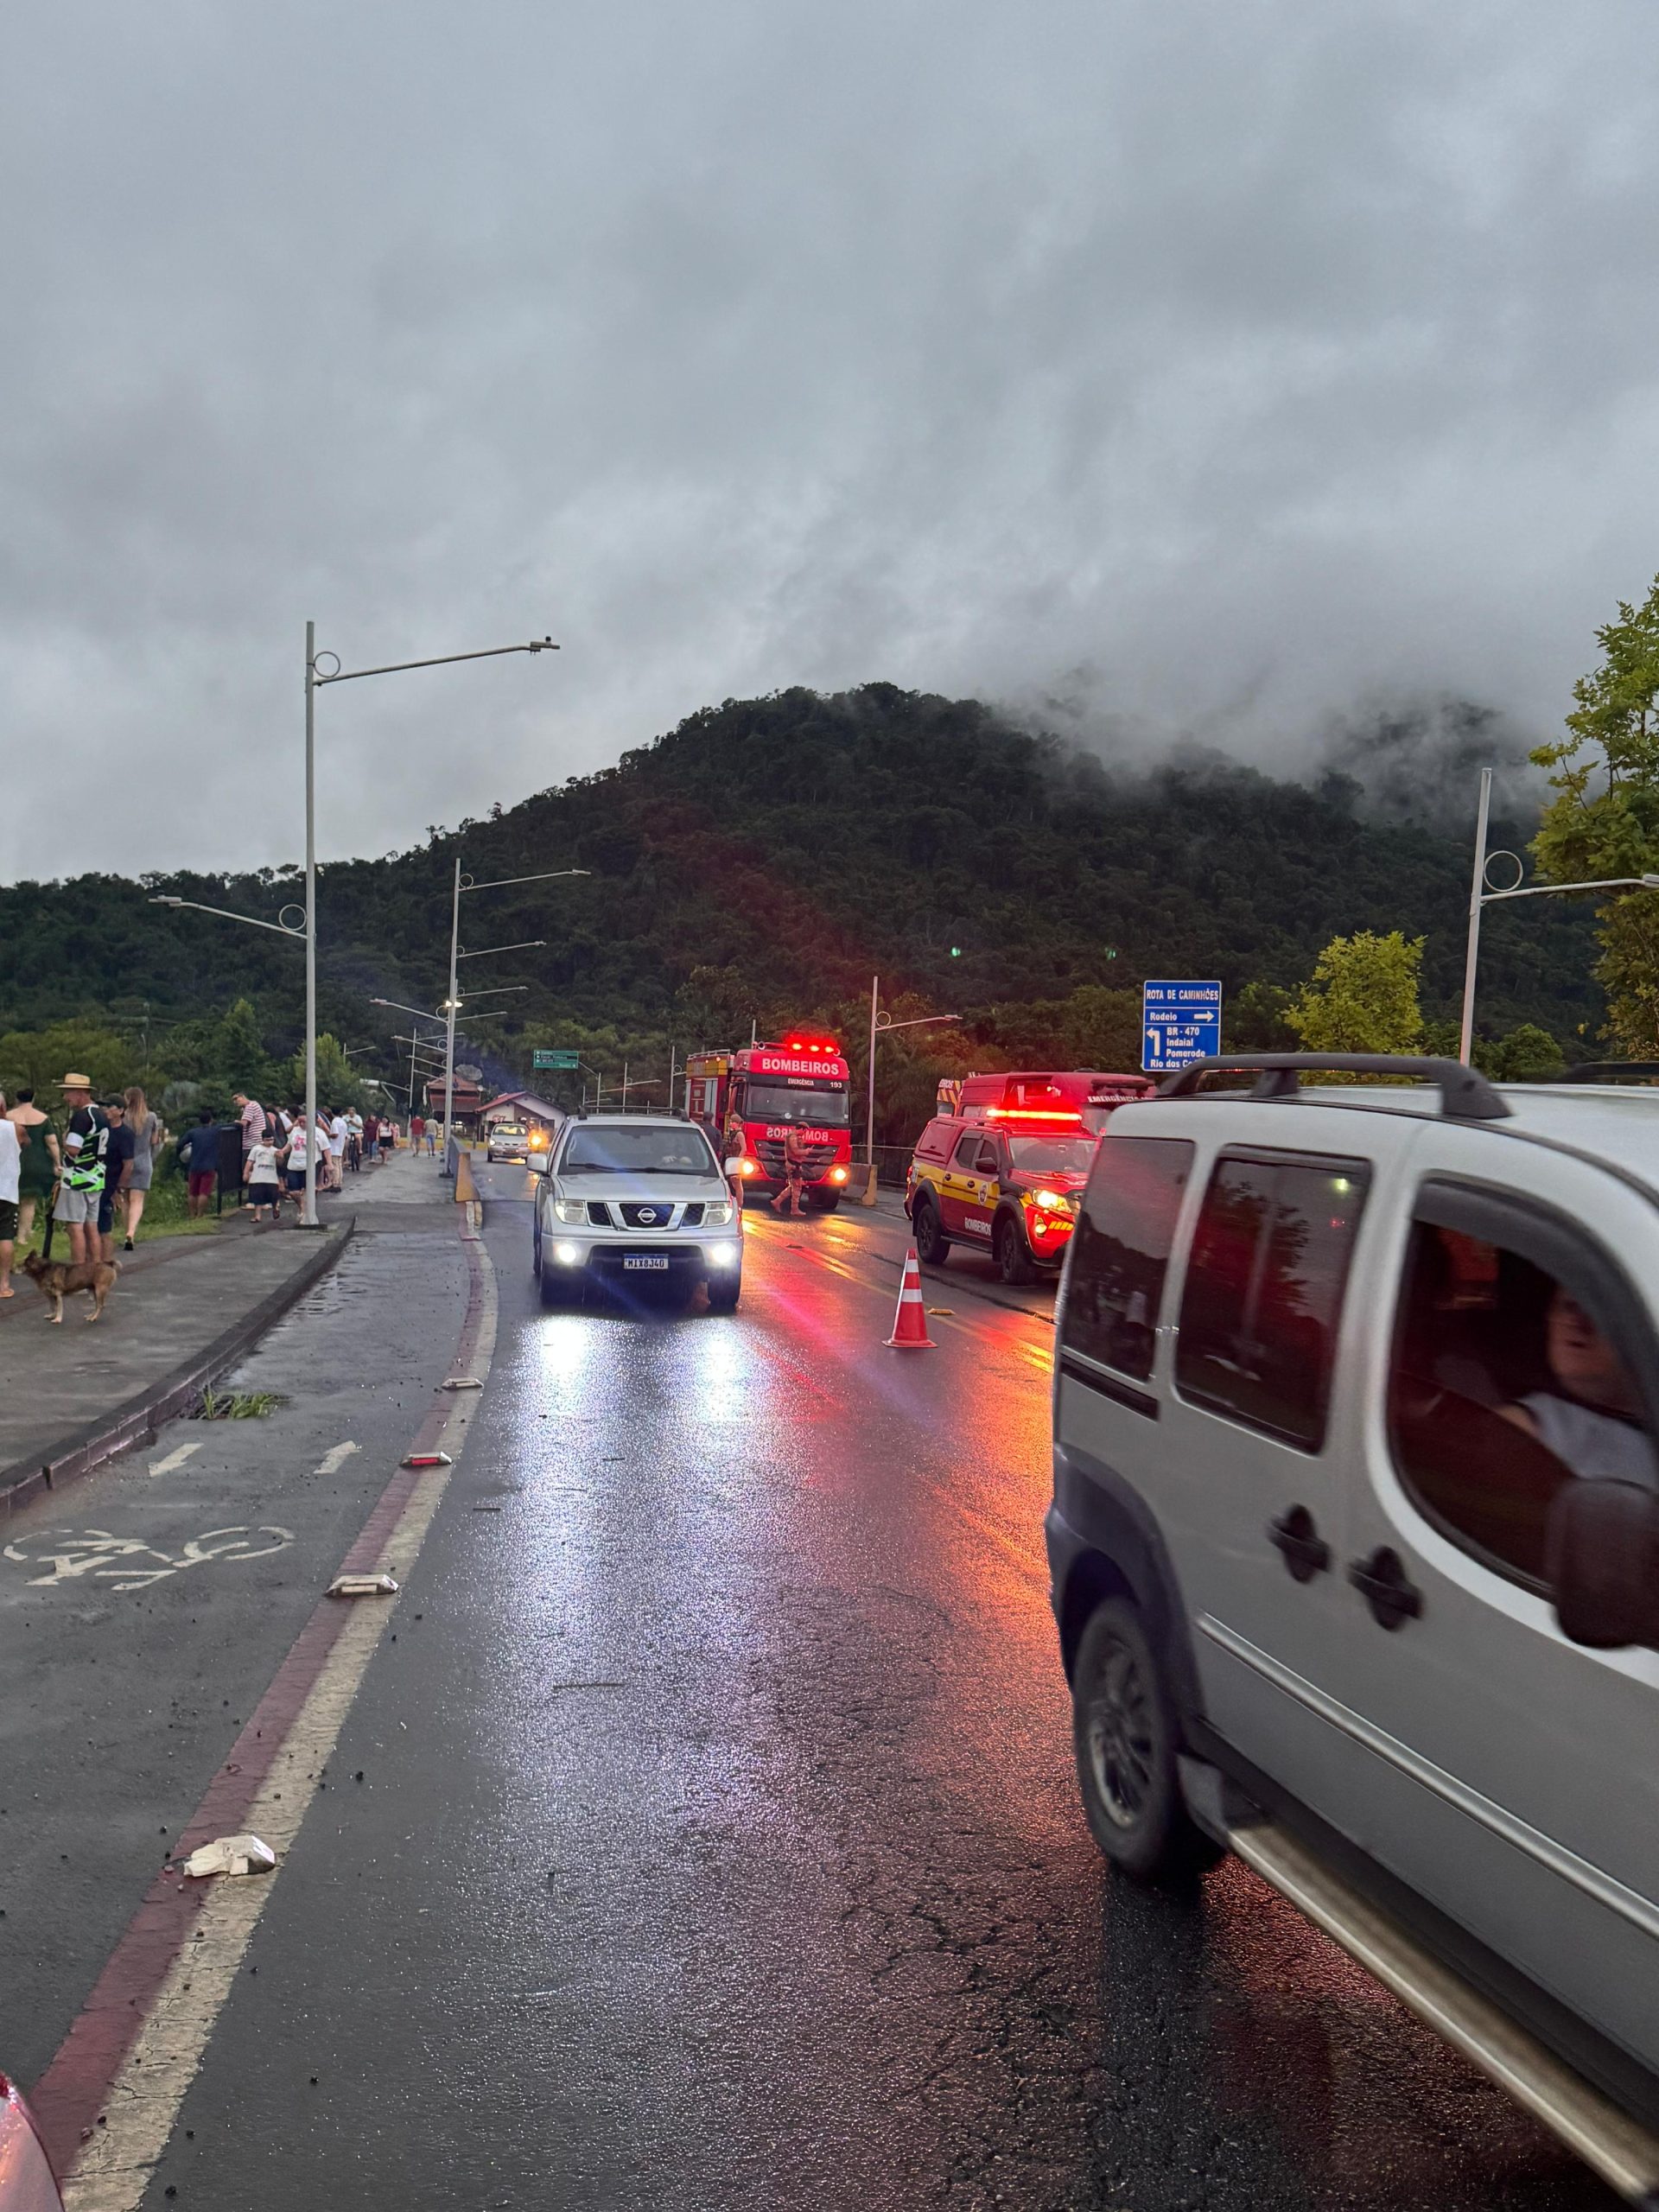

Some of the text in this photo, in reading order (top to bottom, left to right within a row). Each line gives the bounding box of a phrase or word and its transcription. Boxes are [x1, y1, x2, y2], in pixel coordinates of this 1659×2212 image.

[1146, 989, 1164, 1000] ROTA
[1167, 989, 1176, 1001] DE
[1149, 1012, 1178, 1021] Rodeio
[1166, 1027, 1179, 1036] BR
[1185, 1027, 1200, 1036] 470
[1166, 1038, 1194, 1047] Indaial
[1166, 1048, 1206, 1058] Pomerode
[762, 1058, 839, 1076] BOMBEIROS
[1150, 1058, 1164, 1068] Rio
[1166, 1058, 1180, 1068] dos
[964, 1217, 992, 1236] BOMBEIROS
